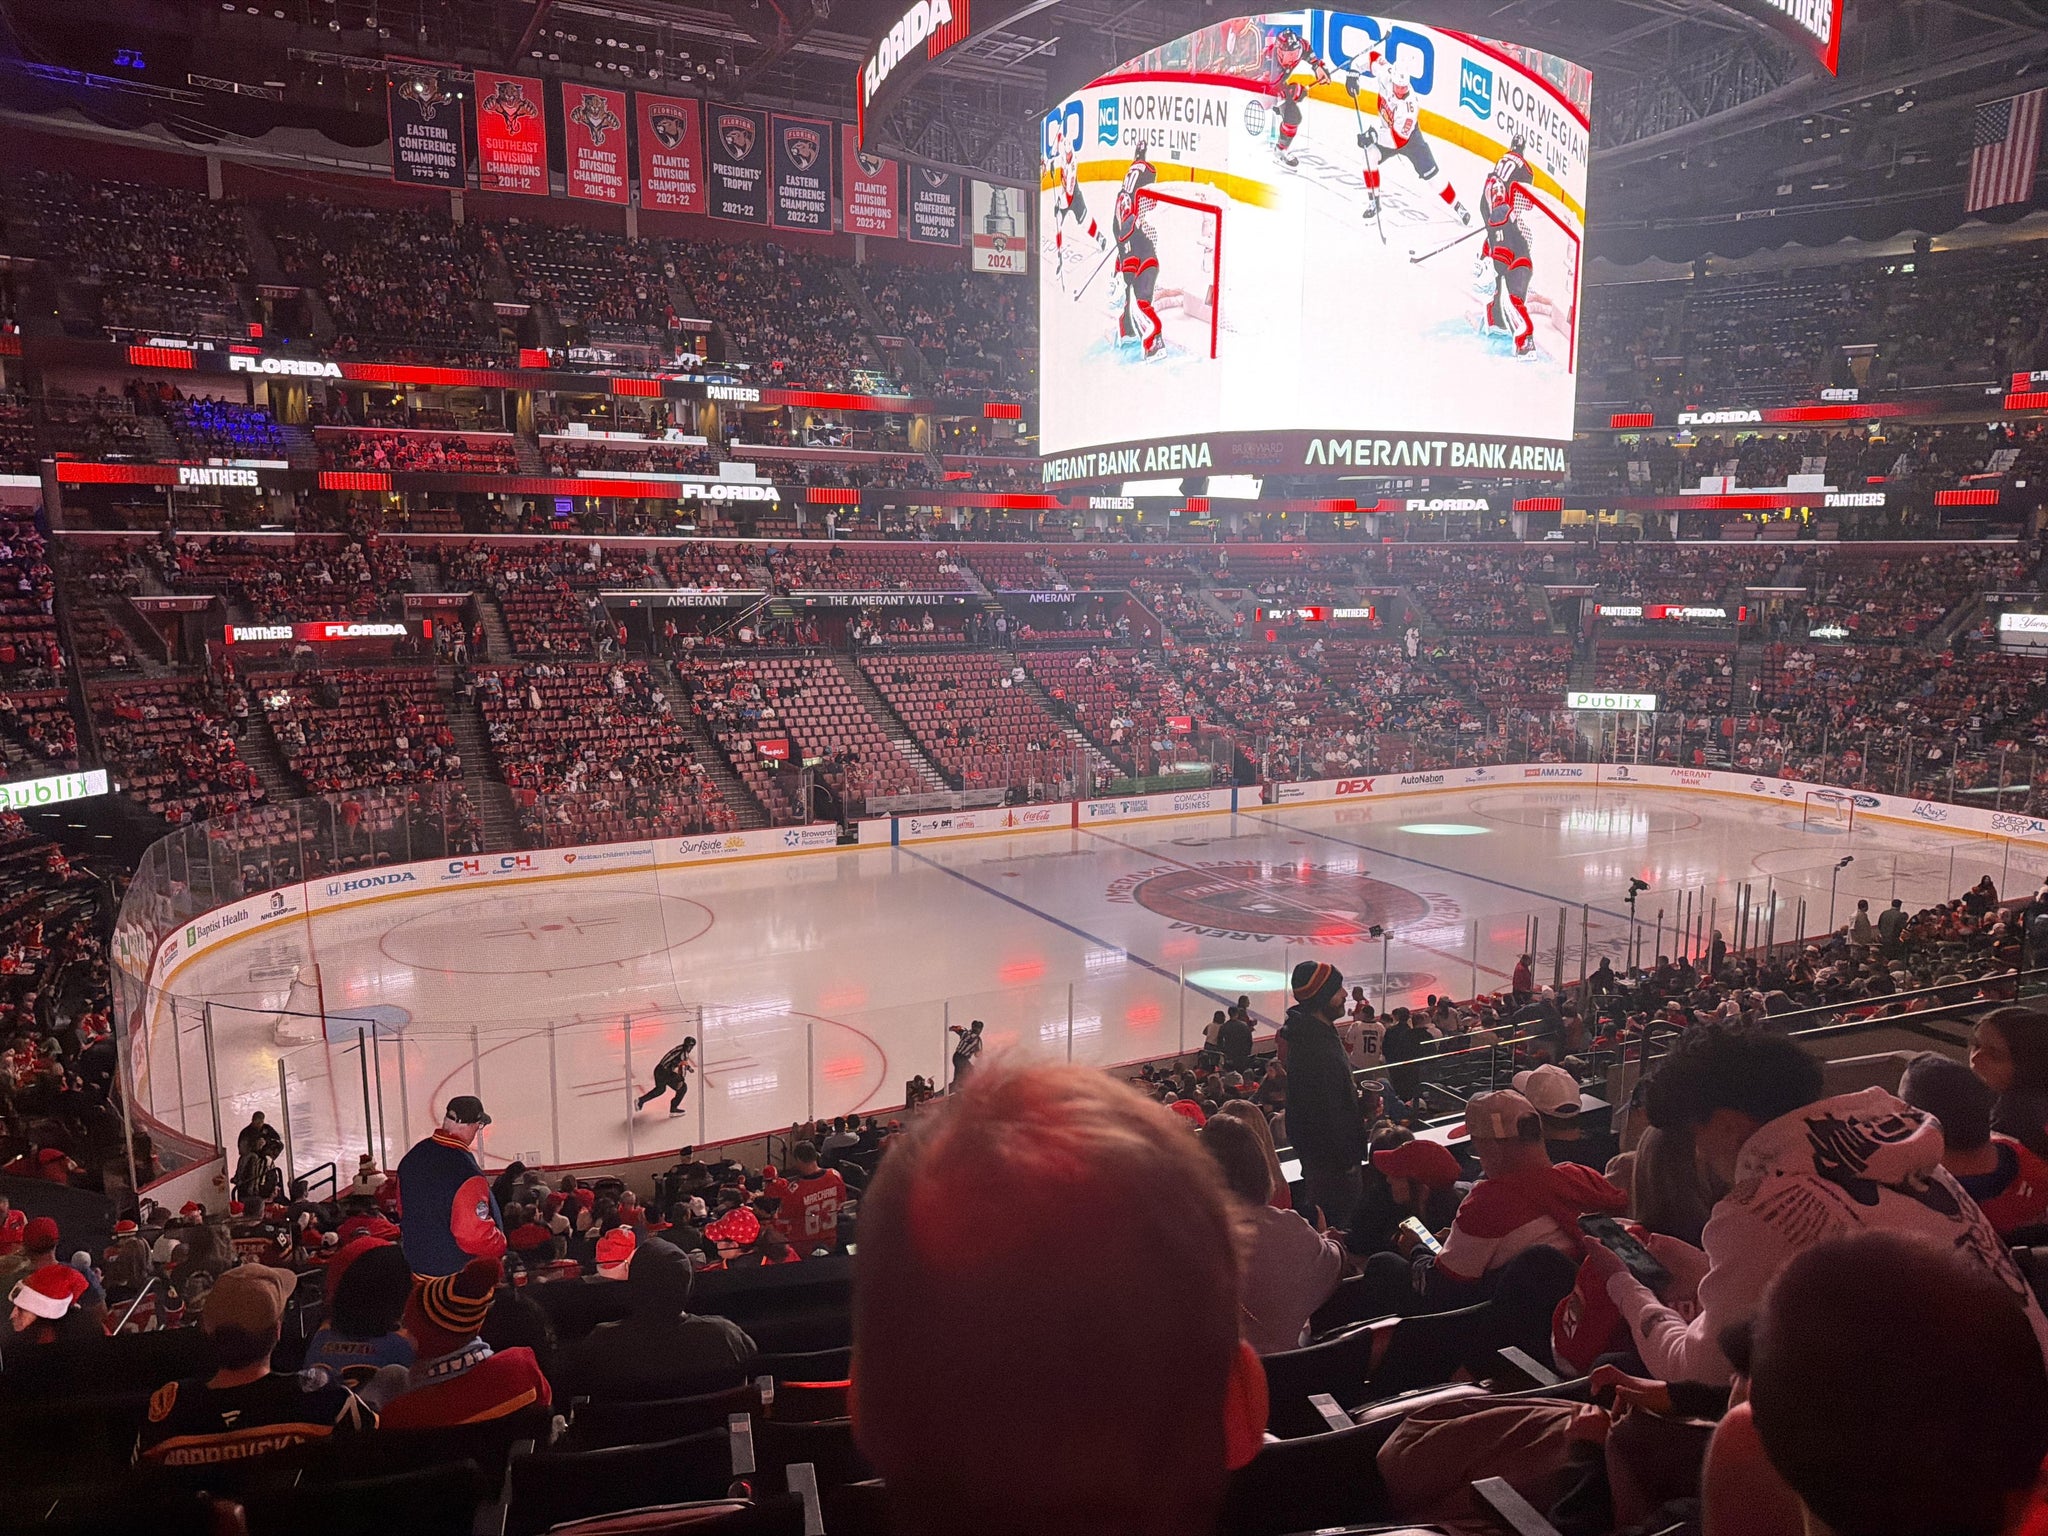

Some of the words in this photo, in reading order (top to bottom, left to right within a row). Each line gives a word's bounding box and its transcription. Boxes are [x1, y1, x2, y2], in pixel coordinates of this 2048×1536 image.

[865, 0, 952, 107] FLORIDA
[1462, 66, 1491, 99] NCL
[1099, 108, 1118, 127] NCL
[1123, 95, 1228, 127] NORWEGIAN
[1498, 76, 1587, 169] NORWEGIAN
[407, 124, 448, 140] EASTERN
[399, 137, 457, 155] CONFERENCE
[486, 138, 539, 154] SOUTHEAST
[1123, 128, 1165, 148] CRUISE
[1169, 131, 1197, 152] LINE
[1496, 111, 1542, 153] CRUISE
[1546, 142, 1568, 176] LINE
[401, 150, 456, 168] CHAMPIONS
[493, 151, 533, 165] DIVISION
[578, 148, 617, 164] ATLANTIC
[652, 154, 690, 168] ATLANTIC
[486, 161, 541, 178] CHAMPIONS
[579, 160, 616, 175] DIVISION
[653, 167, 690, 180] DIVISION
[713, 163, 762, 180] PRESIDENTS'
[498, 176, 531, 189] 2011-12
[573, 170, 623, 187] CHAMPIONS
[722, 177, 753, 192] TROPHY
[786, 175, 819, 189] EASTERN
[584, 185, 616, 199] 2015-16
[648, 179, 697, 194] CHAMPIONS
[779, 186, 826, 201] CONFERENCE
[854, 181, 887, 195] ATLANTIC
[656, 193, 690, 206] 2021-22
[780, 198, 825, 213] CHAMPIONS
[855, 194, 887, 207] DIVISION
[920, 191, 950, 205] EASTERN
[722, 202, 754, 217] 2021-22
[850, 204, 891, 220] CHAMPIONS
[914, 203, 956, 217] CONFERENCE
[787, 211, 819, 224] 2022-23
[856, 216, 886, 230] 2023-24
[915, 214, 955, 229] CHAMPIONS
[921, 226, 949, 239] 2023-24
[987, 253, 1013, 269] 2024
[229, 356, 343, 378] FLORIDA
[707, 385, 760, 402] PANTHERS
[1678, 410, 1762, 425] FLORIDA
[1042, 453, 1096, 484] AMERANT
[1098, 447, 1141, 476] BANK
[1143, 442, 1213, 472] ARENA
[1304, 439, 1451, 468] AMERANT
[1452, 442, 1506, 469] BANK
[1508, 444, 1566, 472] ARENA
[179, 467, 259, 487] PANTHERS
[682, 483, 781, 501] FLORIDA
[1089, 496, 1135, 510] PANTHERS
[1405, 498, 1490, 512] FLORIDA
[1824, 493, 1886, 507] PANTHERS
[667, 595, 729, 606] AMERANT
[829, 595, 847, 606] THE
[851, 595, 905, 606] AMERANT
[909, 595, 944, 606] VAULT
[1028, 593, 1077, 603] AMERANT
[1333, 608, 1369, 618] PANTHERS
[1600, 606, 1642, 617] PANTHERS
[233, 626, 293, 641] PANTHERS
[325, 624, 408, 637] FLORIDA
[1576, 694, 1642, 710] Publix
[1401, 774, 1444, 785] AutoNation
[1541, 768, 1583, 777] AMAZING
[1670, 769, 1712, 780] AMERANT
[1335, 778, 1376, 795] DEX
[1681, 778, 1701, 786] BANK
[1174, 793, 1210, 802] COMCAST
[1174, 801, 1210, 811] BUSINESS
[1991, 820, 2027, 834] SPORT
[1992, 813, 2029, 826] OMEGA
[2026, 820, 2046, 832] XL
[801, 829, 833, 838] Broward
[679, 839, 722, 855] Surfside
[342, 871, 417, 893] HONDA
[197, 918, 221, 940] Baptist
[222, 908, 249, 929] Health
[1362, 1035, 1377, 1054] 16
[805, 1198, 838, 1236] 63
